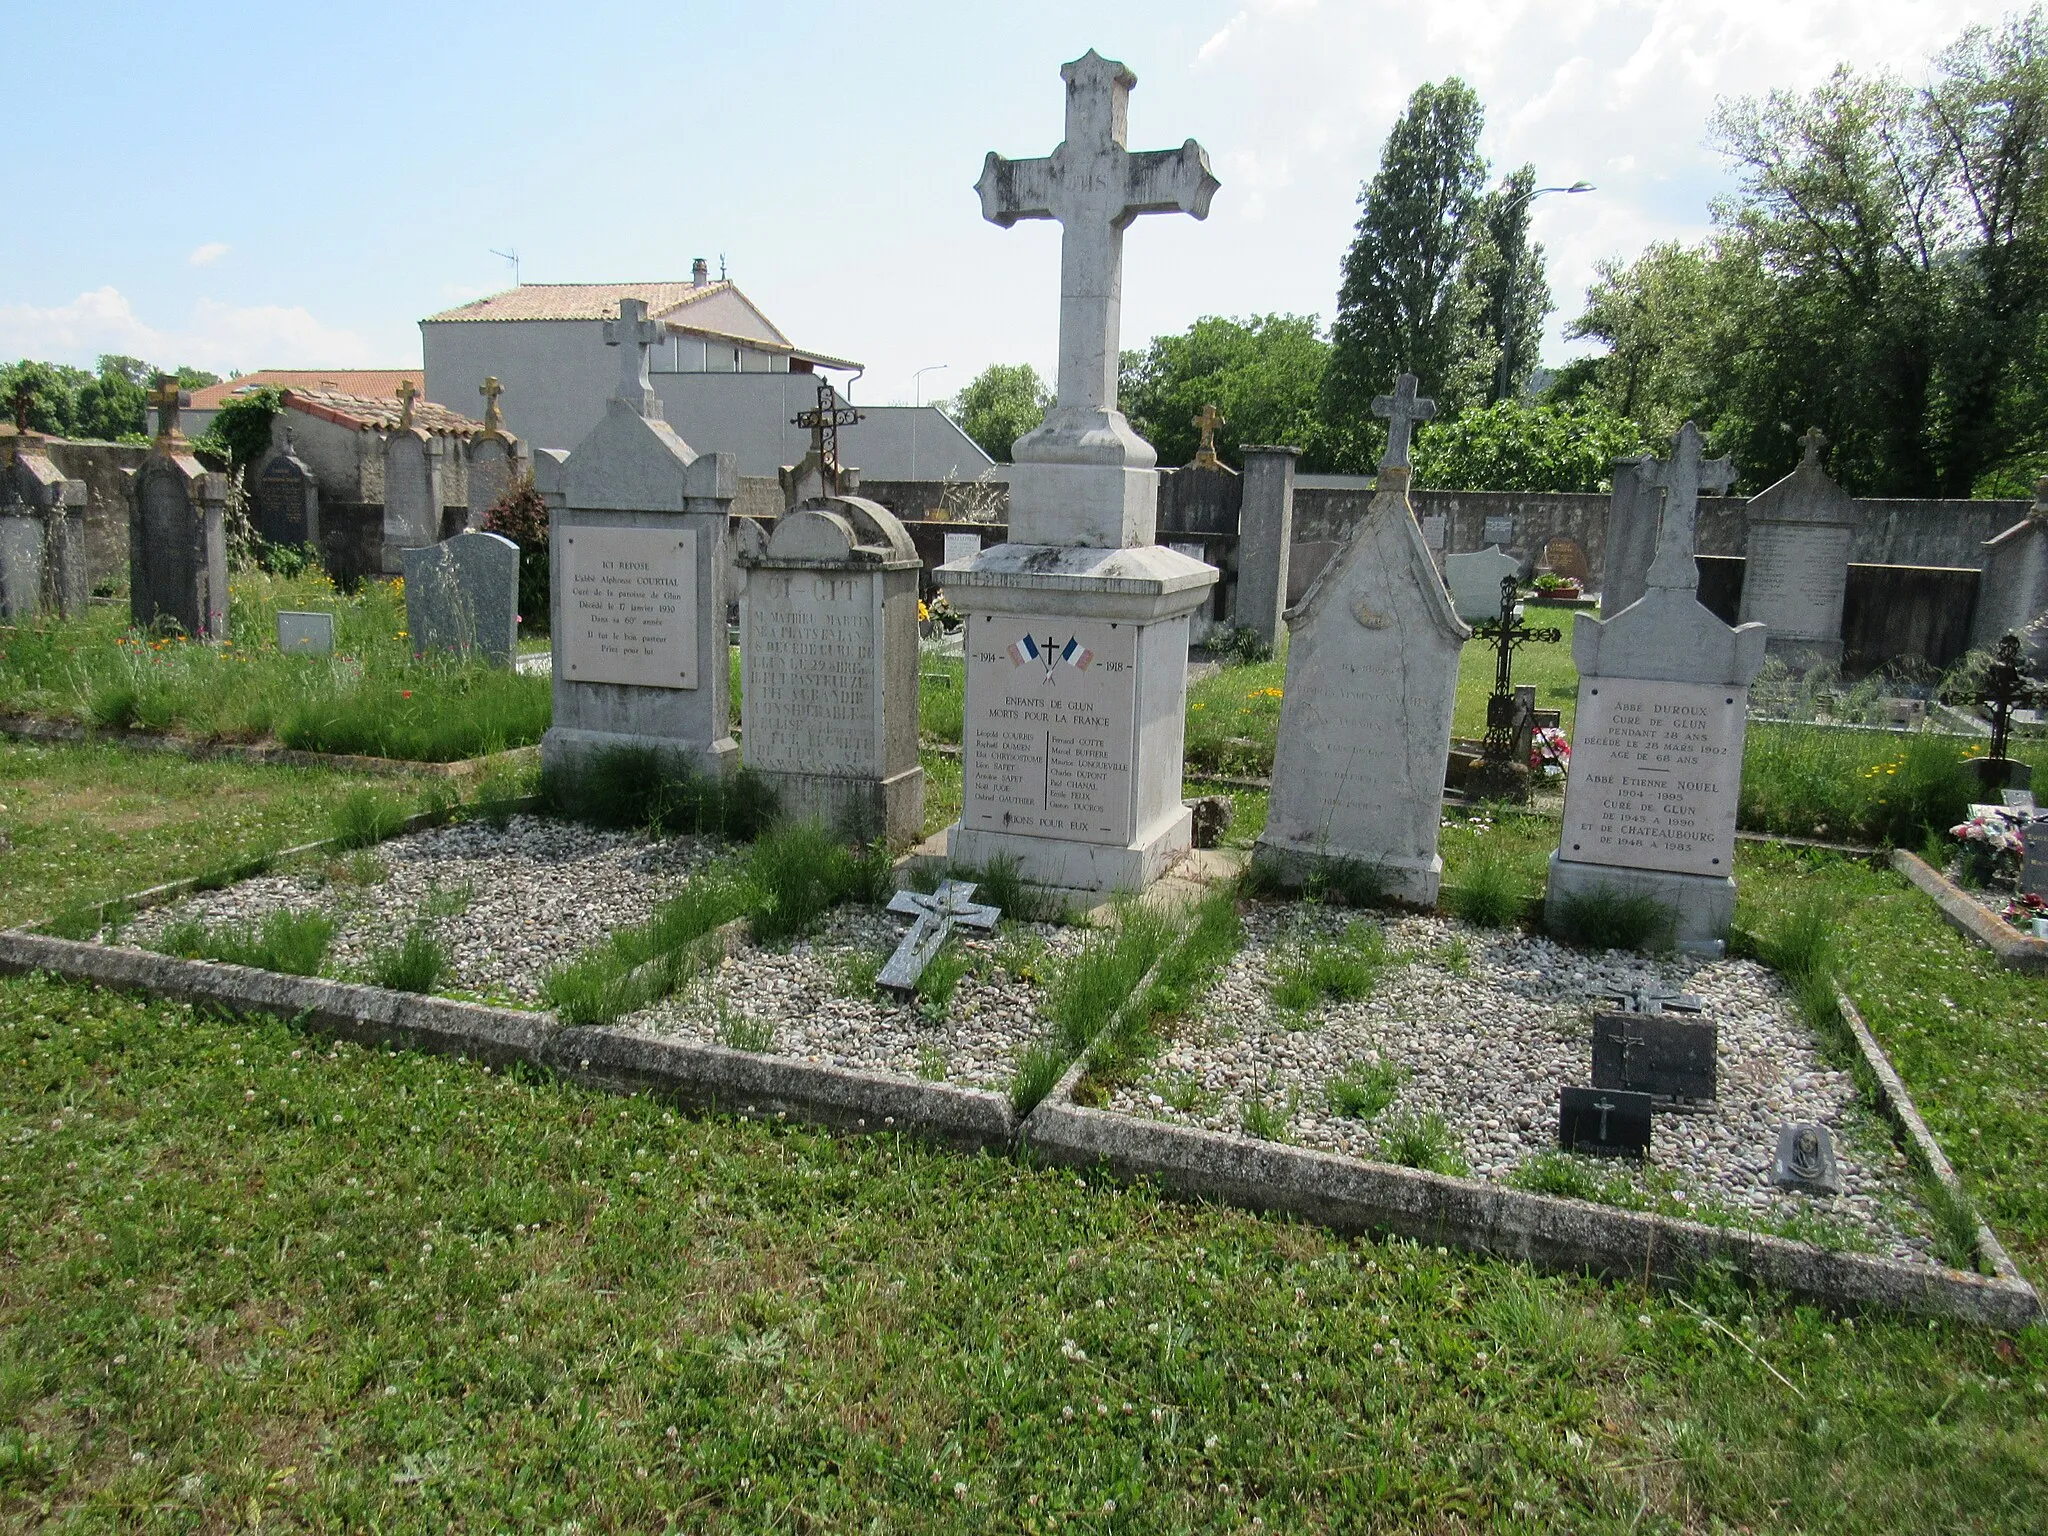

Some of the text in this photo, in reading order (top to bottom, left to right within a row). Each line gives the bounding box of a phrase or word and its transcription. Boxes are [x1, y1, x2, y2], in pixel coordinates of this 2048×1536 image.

[602, 561, 649, 571] ICI REPOSE
[637, 578, 679, 587] COURTIAL
[594, 588, 602, 596] de
[607, 589, 613, 597] la
[618, 590, 645, 598] paroisse
[650, 591, 658, 599] de
[664, 592, 681, 600] Glun
[608, 602, 614, 610] le
[620, 603, 625, 611] 17
[659, 605, 675, 613] 1930
[591, 615, 608, 623] Dans
[613, 632, 620, 640] le
[624, 633, 637, 641] bon
[642, 635, 667, 643] pasteur
[980, 652, 1124, 672] 1914 1918
[1005, 696, 1094, 712] ENFANTS DE GLUN
[1654, 704, 1708, 716] DUROUX
[989, 709, 1110, 727] MORTS POUR LA FRANCE
[1650, 718, 1662, 726] DE
[1673, 720, 1706, 729] GLUN
[1608, 728, 1656, 738] PENDANT
[1051, 735, 1075, 745] Fernand
[1051, 746, 1071, 756] Marcel
[1645, 742, 1658, 750] 28
[1664, 743, 1694, 752] MARS
[1701, 746, 1727, 755] 1902
[1051, 757, 1128, 772] Maurice LONGUEVILLE
[1677, 756, 1698, 765] ANS
[976, 772, 997, 780] Antoine
[1051, 768, 1107, 780] Charles DUPONT
[1066, 781, 1096, 790] CHANAL
[1622, 776, 1668, 788] ETIENNE
[1677, 781, 1719, 793] NOUEL
[999, 795, 1035, 806] GAUTHIER
[1618, 789, 1644, 798] 1904
[1658, 792, 1683, 801] 1995
[1049, 800, 1103, 813] Gaston DUCROS
[1663, 804, 1696, 815] GLUN
[1040, 819, 1064, 829] POUR
[1071, 821, 1088, 831] EUX
[1602, 812, 1614, 820] DE
[1621, 814, 1646, 822] 1945
[1668, 818, 1694, 827] 1990
[1581, 823, 1715, 842] ET DE CHATEAUBOURG
[1600, 836, 1613, 844] DE
[1618, 838, 1643, 847] 1948
